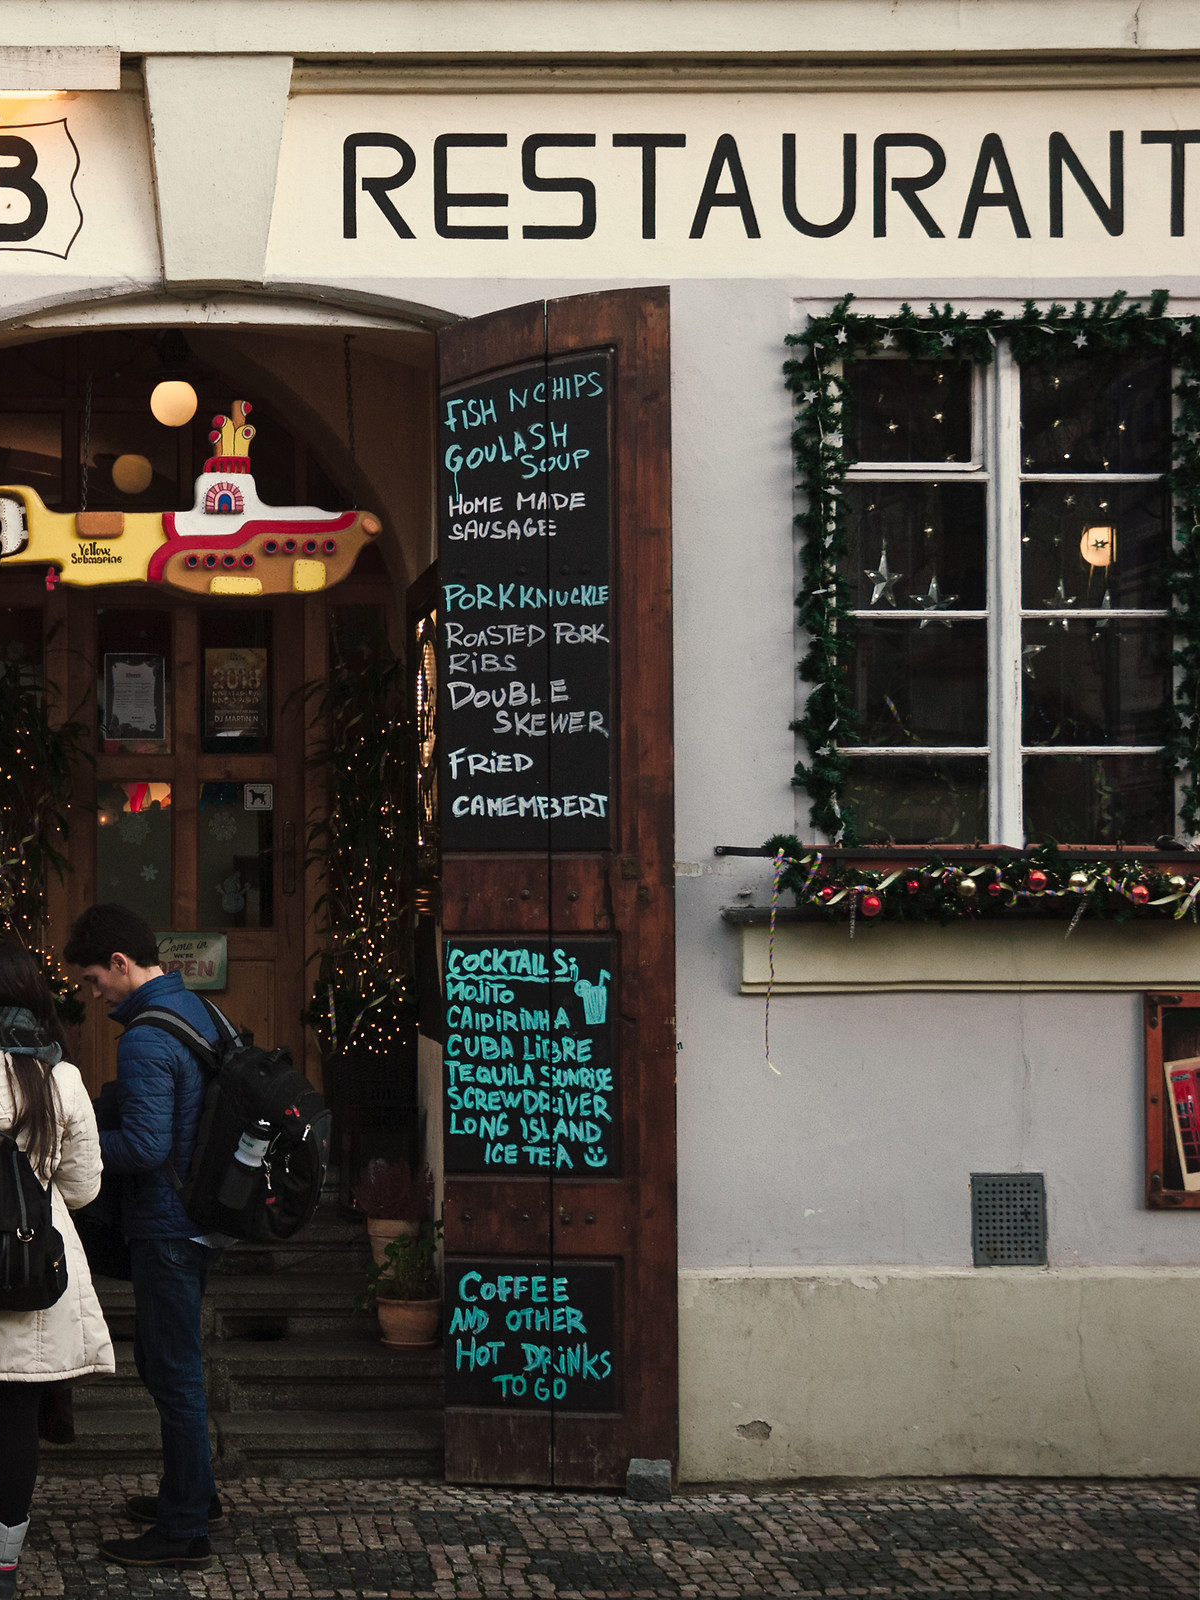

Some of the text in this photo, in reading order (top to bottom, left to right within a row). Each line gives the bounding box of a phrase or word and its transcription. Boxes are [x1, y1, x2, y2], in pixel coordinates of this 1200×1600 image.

[343, 130, 1200, 241] RESTAURANT
[444, 399, 497, 432] FISH
[445, 421, 568, 473] GOULASH
[520, 449, 590, 479] SOUP
[448, 492, 586, 517] HOME MADE
[448, 518, 557, 541] SAUSAGE
[71, 553, 123, 564] Submarine
[78, 542, 111, 556] Yellow
[443, 583, 609, 612] PORK KNUCKLE
[445, 622, 610, 649] ROASTED PORK
[212, 668, 261, 690] 2018
[447, 679, 572, 710] DOUBLE
[214, 715, 223, 723] DJ
[225, 715, 250, 723] MARTIN
[493, 710, 609, 738] SKEWER
[452, 793, 608, 819] CAMEMBERT
[157, 936, 208, 954] Come in
[448, 948, 568, 975] COCKTAILS
[446, 1034, 514, 1060] CUBA
[449, 1112, 602, 1143] LONG ISLAND
[484, 1143, 574, 1169] ICE TEA
[458, 1270, 569, 1302] COFFEE
[449, 1305, 587, 1334] AND OTHER
[456, 1337, 505, 1372] HOT
[492, 1374, 567, 1401] TO GO
